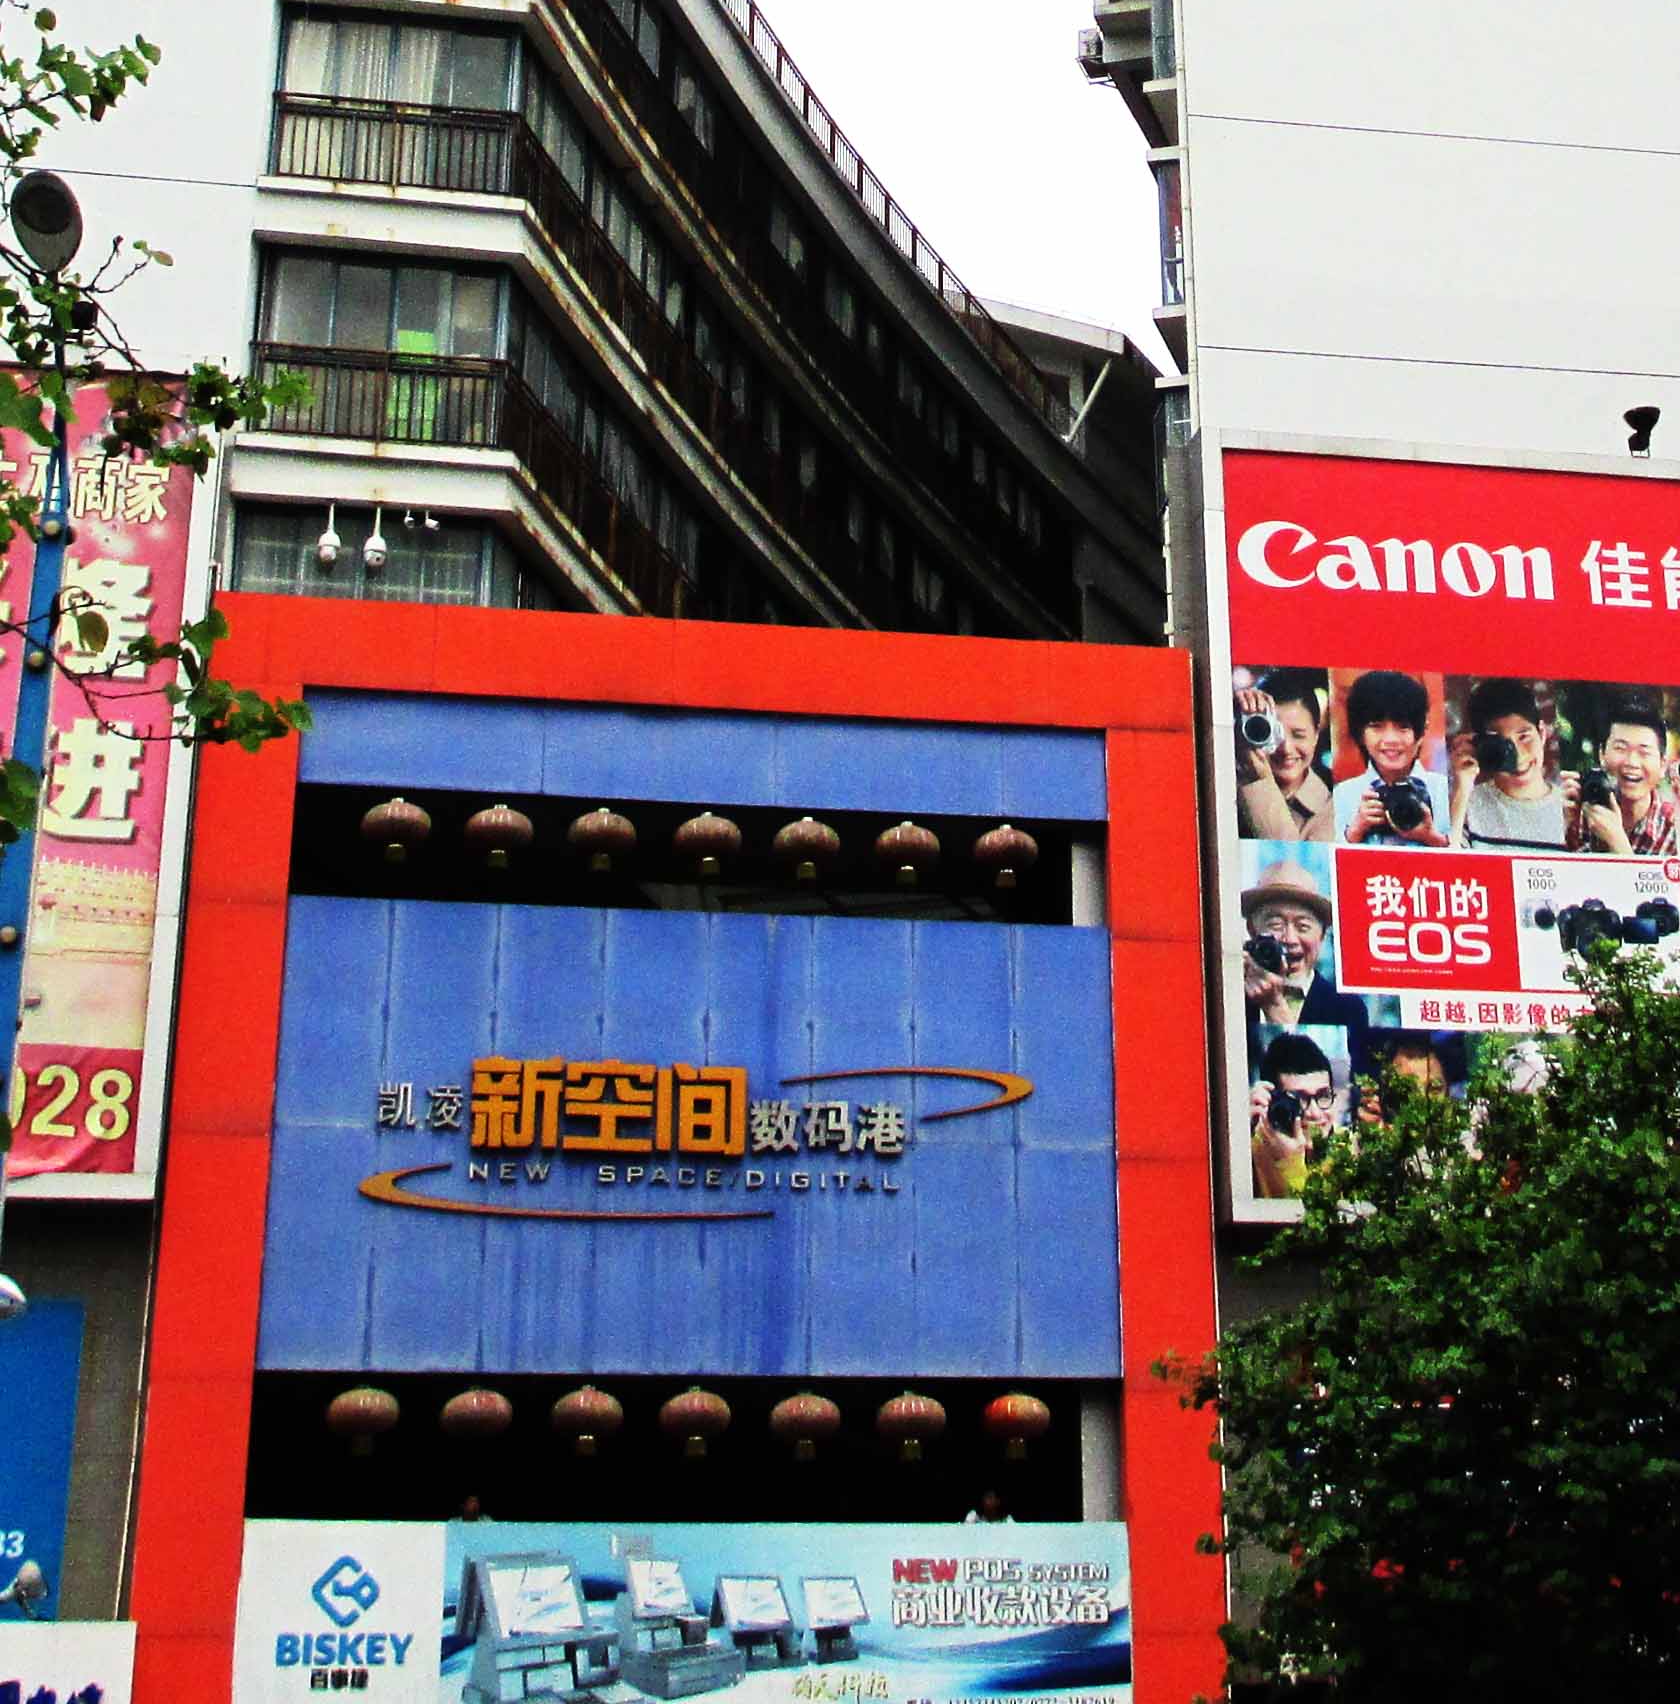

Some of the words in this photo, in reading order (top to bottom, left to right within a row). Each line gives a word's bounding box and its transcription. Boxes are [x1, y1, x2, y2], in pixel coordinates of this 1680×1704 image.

[1237, 520, 1556, 601] Canon
[1527, 879, 1556, 890] 100D
[1528, 867, 1553, 878] EOS
[1634, 882, 1670, 894] 1200D
[1638, 871, 1663, 881] EOS
[1365, 873, 1489, 921] 我们的
[1368, 921, 1492, 966] EOS
[376, 1081, 466, 1130] 凯凌
[469, 1056, 748, 1156] 新空间
[748, 1098, 905, 1156] 数码港
[469, 1162, 551, 1182] NEW
[597, 1165, 724, 1187] SPACE
[745, 1168, 901, 1192] DIGITAL
[892, 1558, 959, 1584] NEW
[963, 1558, 1023, 1584] POS
[1027, 1561, 1110, 1583] SYSTEM
[891, 1585, 1110, 1627] 商业收款设备
[275, 1632, 414, 1668] BISKEY
